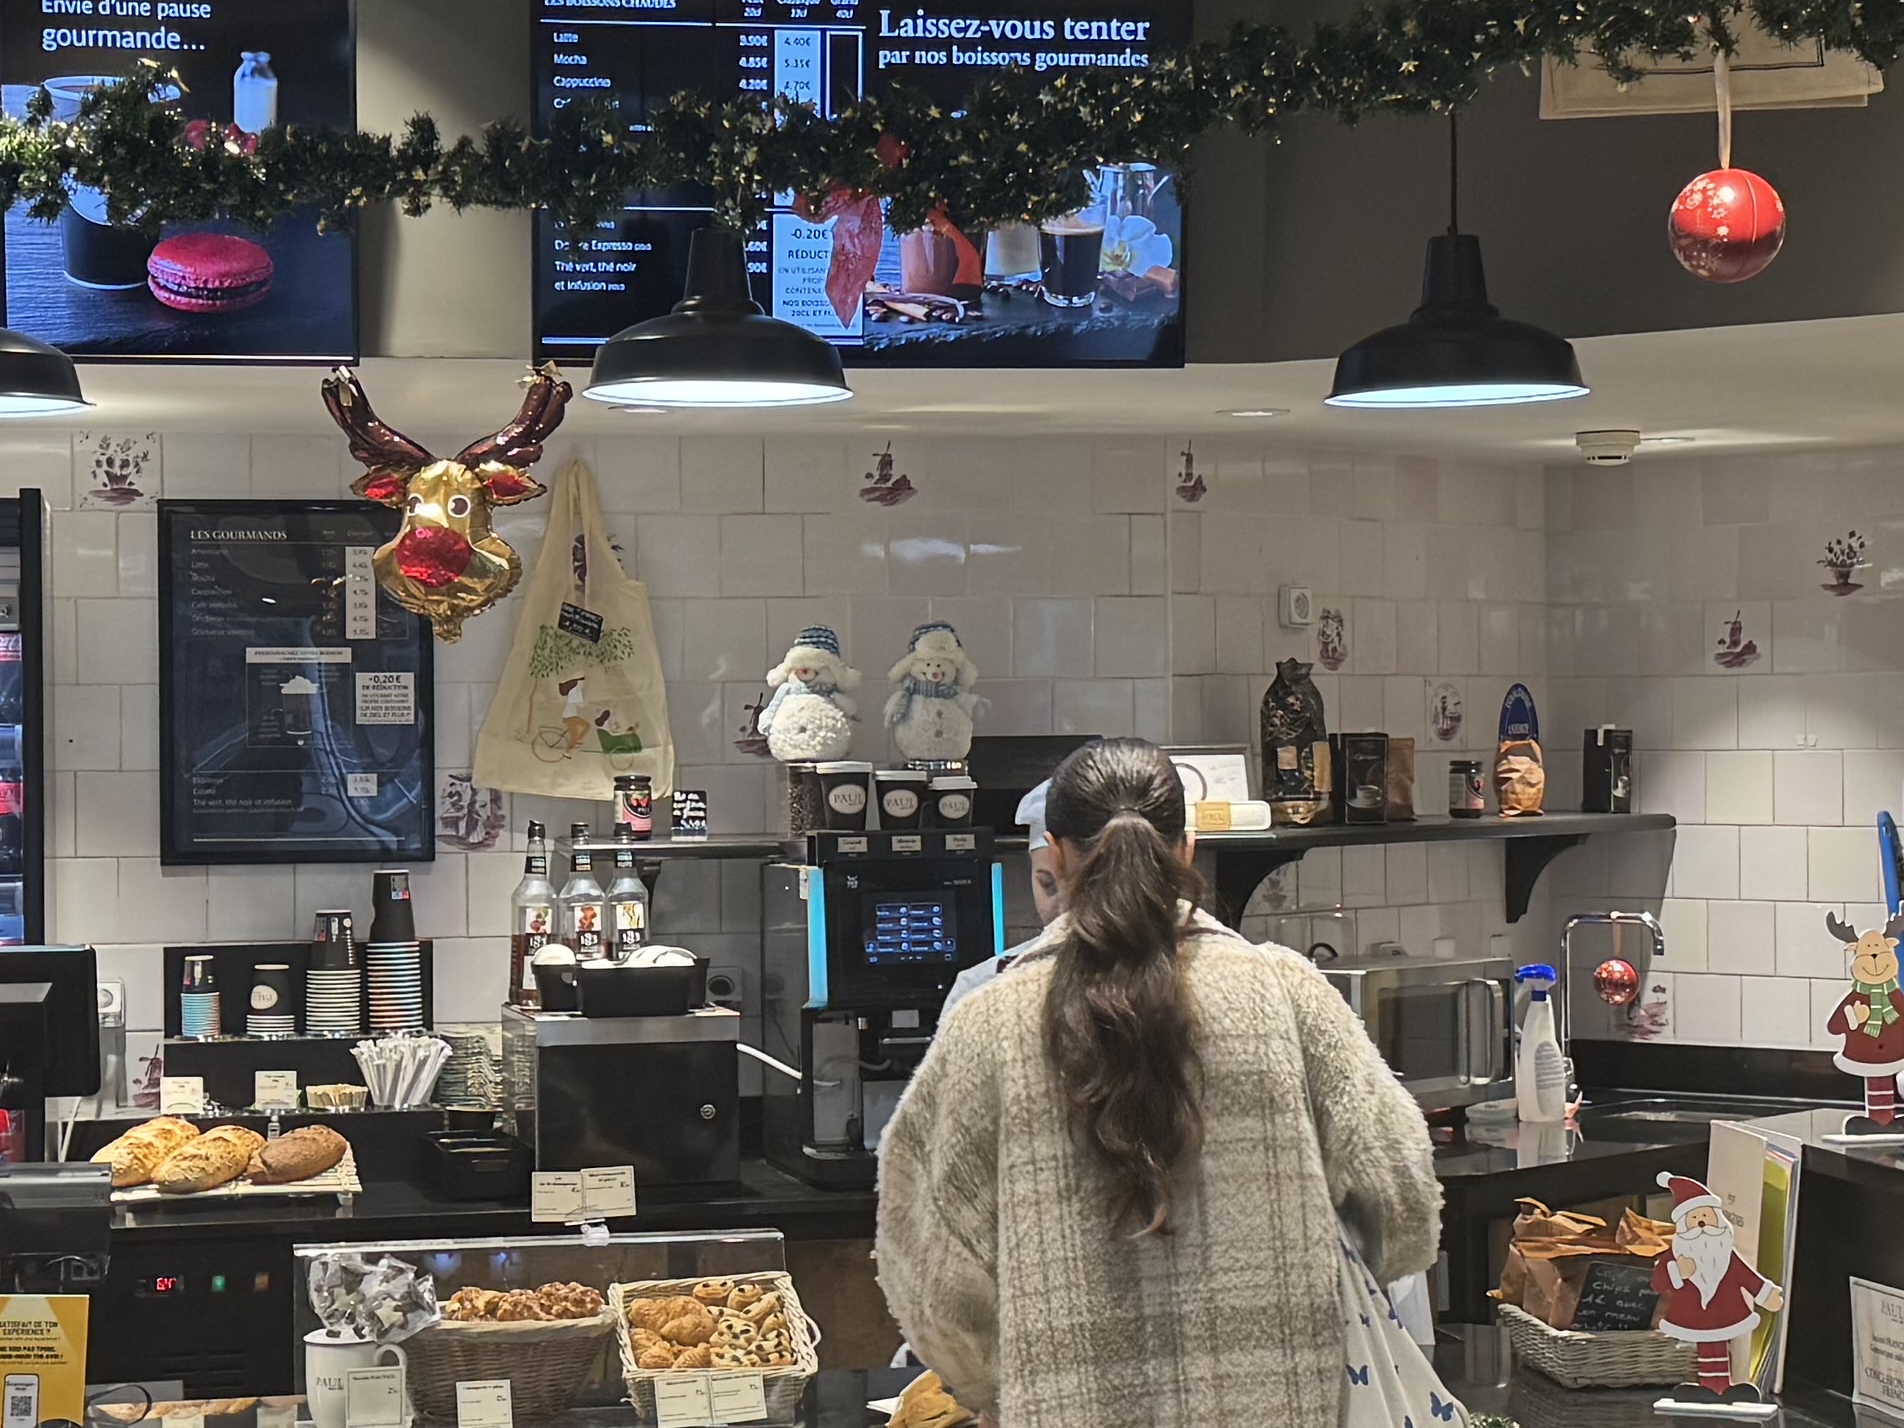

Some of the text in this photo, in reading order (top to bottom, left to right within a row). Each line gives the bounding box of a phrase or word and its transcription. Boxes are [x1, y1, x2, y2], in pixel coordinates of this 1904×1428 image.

[157, 1, 212, 21] pause
[879, 8, 1150, 42] Laissez-vous tenter
[41, 26, 206, 52] gourmande...
[879, 46, 1149, 71] par nos boissons gourmandes
[787, 248, 828, 260] RÉDUCT
[191, 530, 288, 541] LES GOURMANDS
[833, 793, 864, 805] PAUL
[886, 798, 914, 809] PAUL
[1881, 1300, 1904, 1320] PAUL
